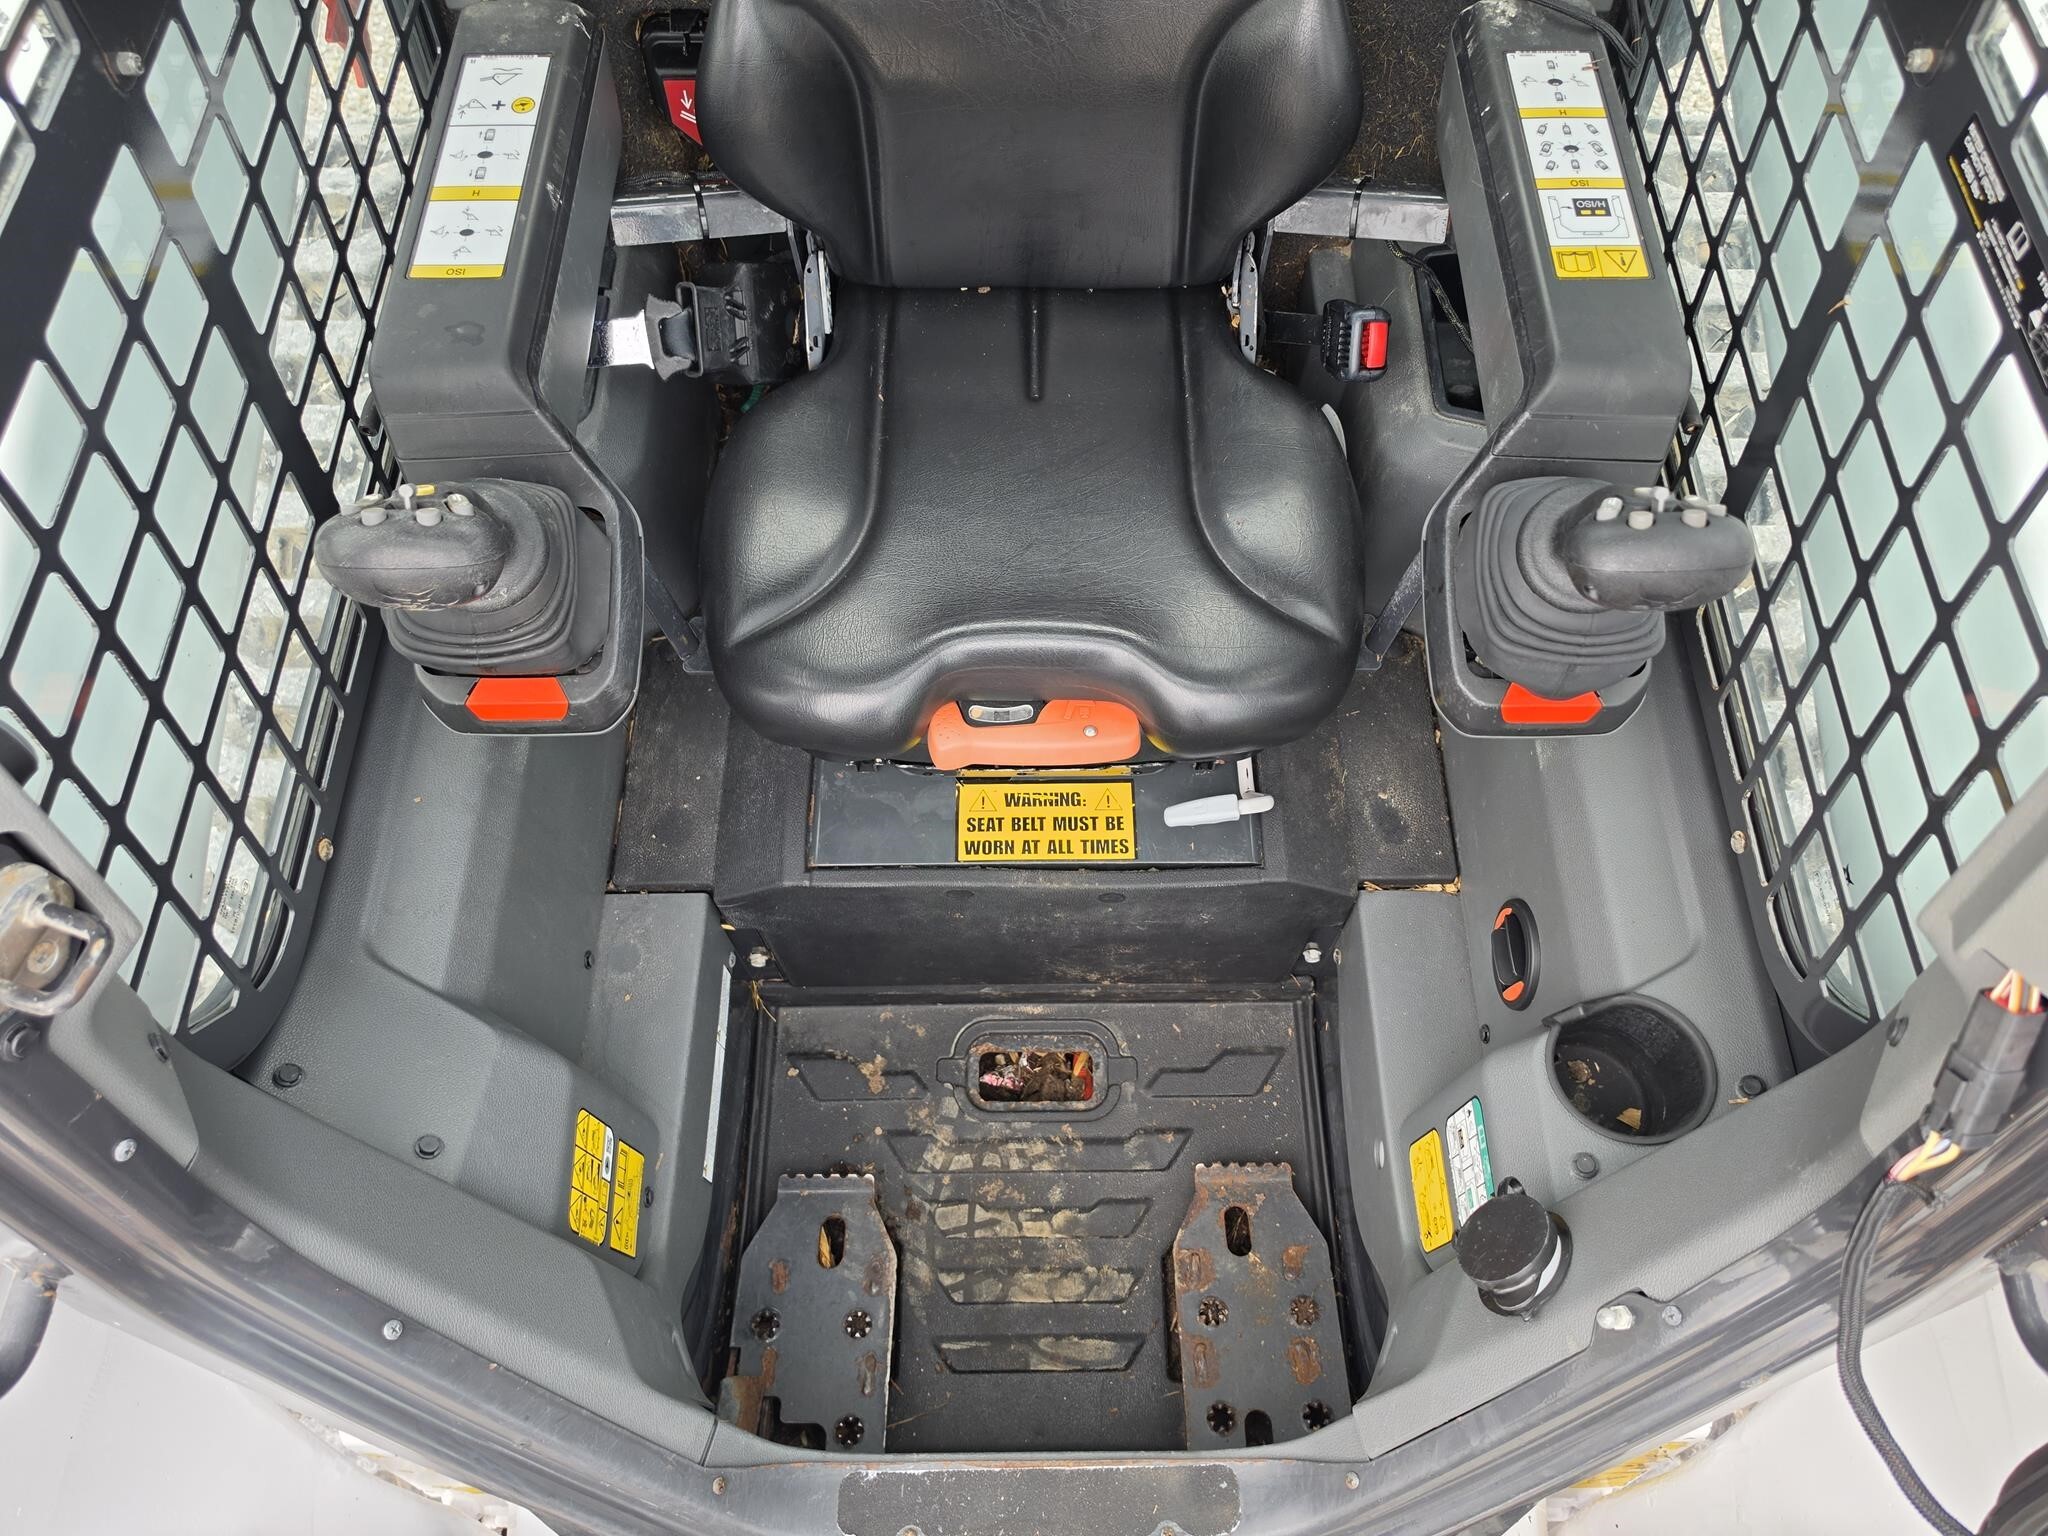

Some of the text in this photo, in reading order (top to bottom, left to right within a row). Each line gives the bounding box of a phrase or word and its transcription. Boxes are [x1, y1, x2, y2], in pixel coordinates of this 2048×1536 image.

[1570, 179, 1590, 187] ISO
[1576, 200, 1606, 208] H/ISO
[446, 268, 466, 276] ISO
[966, 816, 1124, 832] SEAT BELT MUST BE
[964, 838, 1129, 855] WORN AT ALL TIMES
